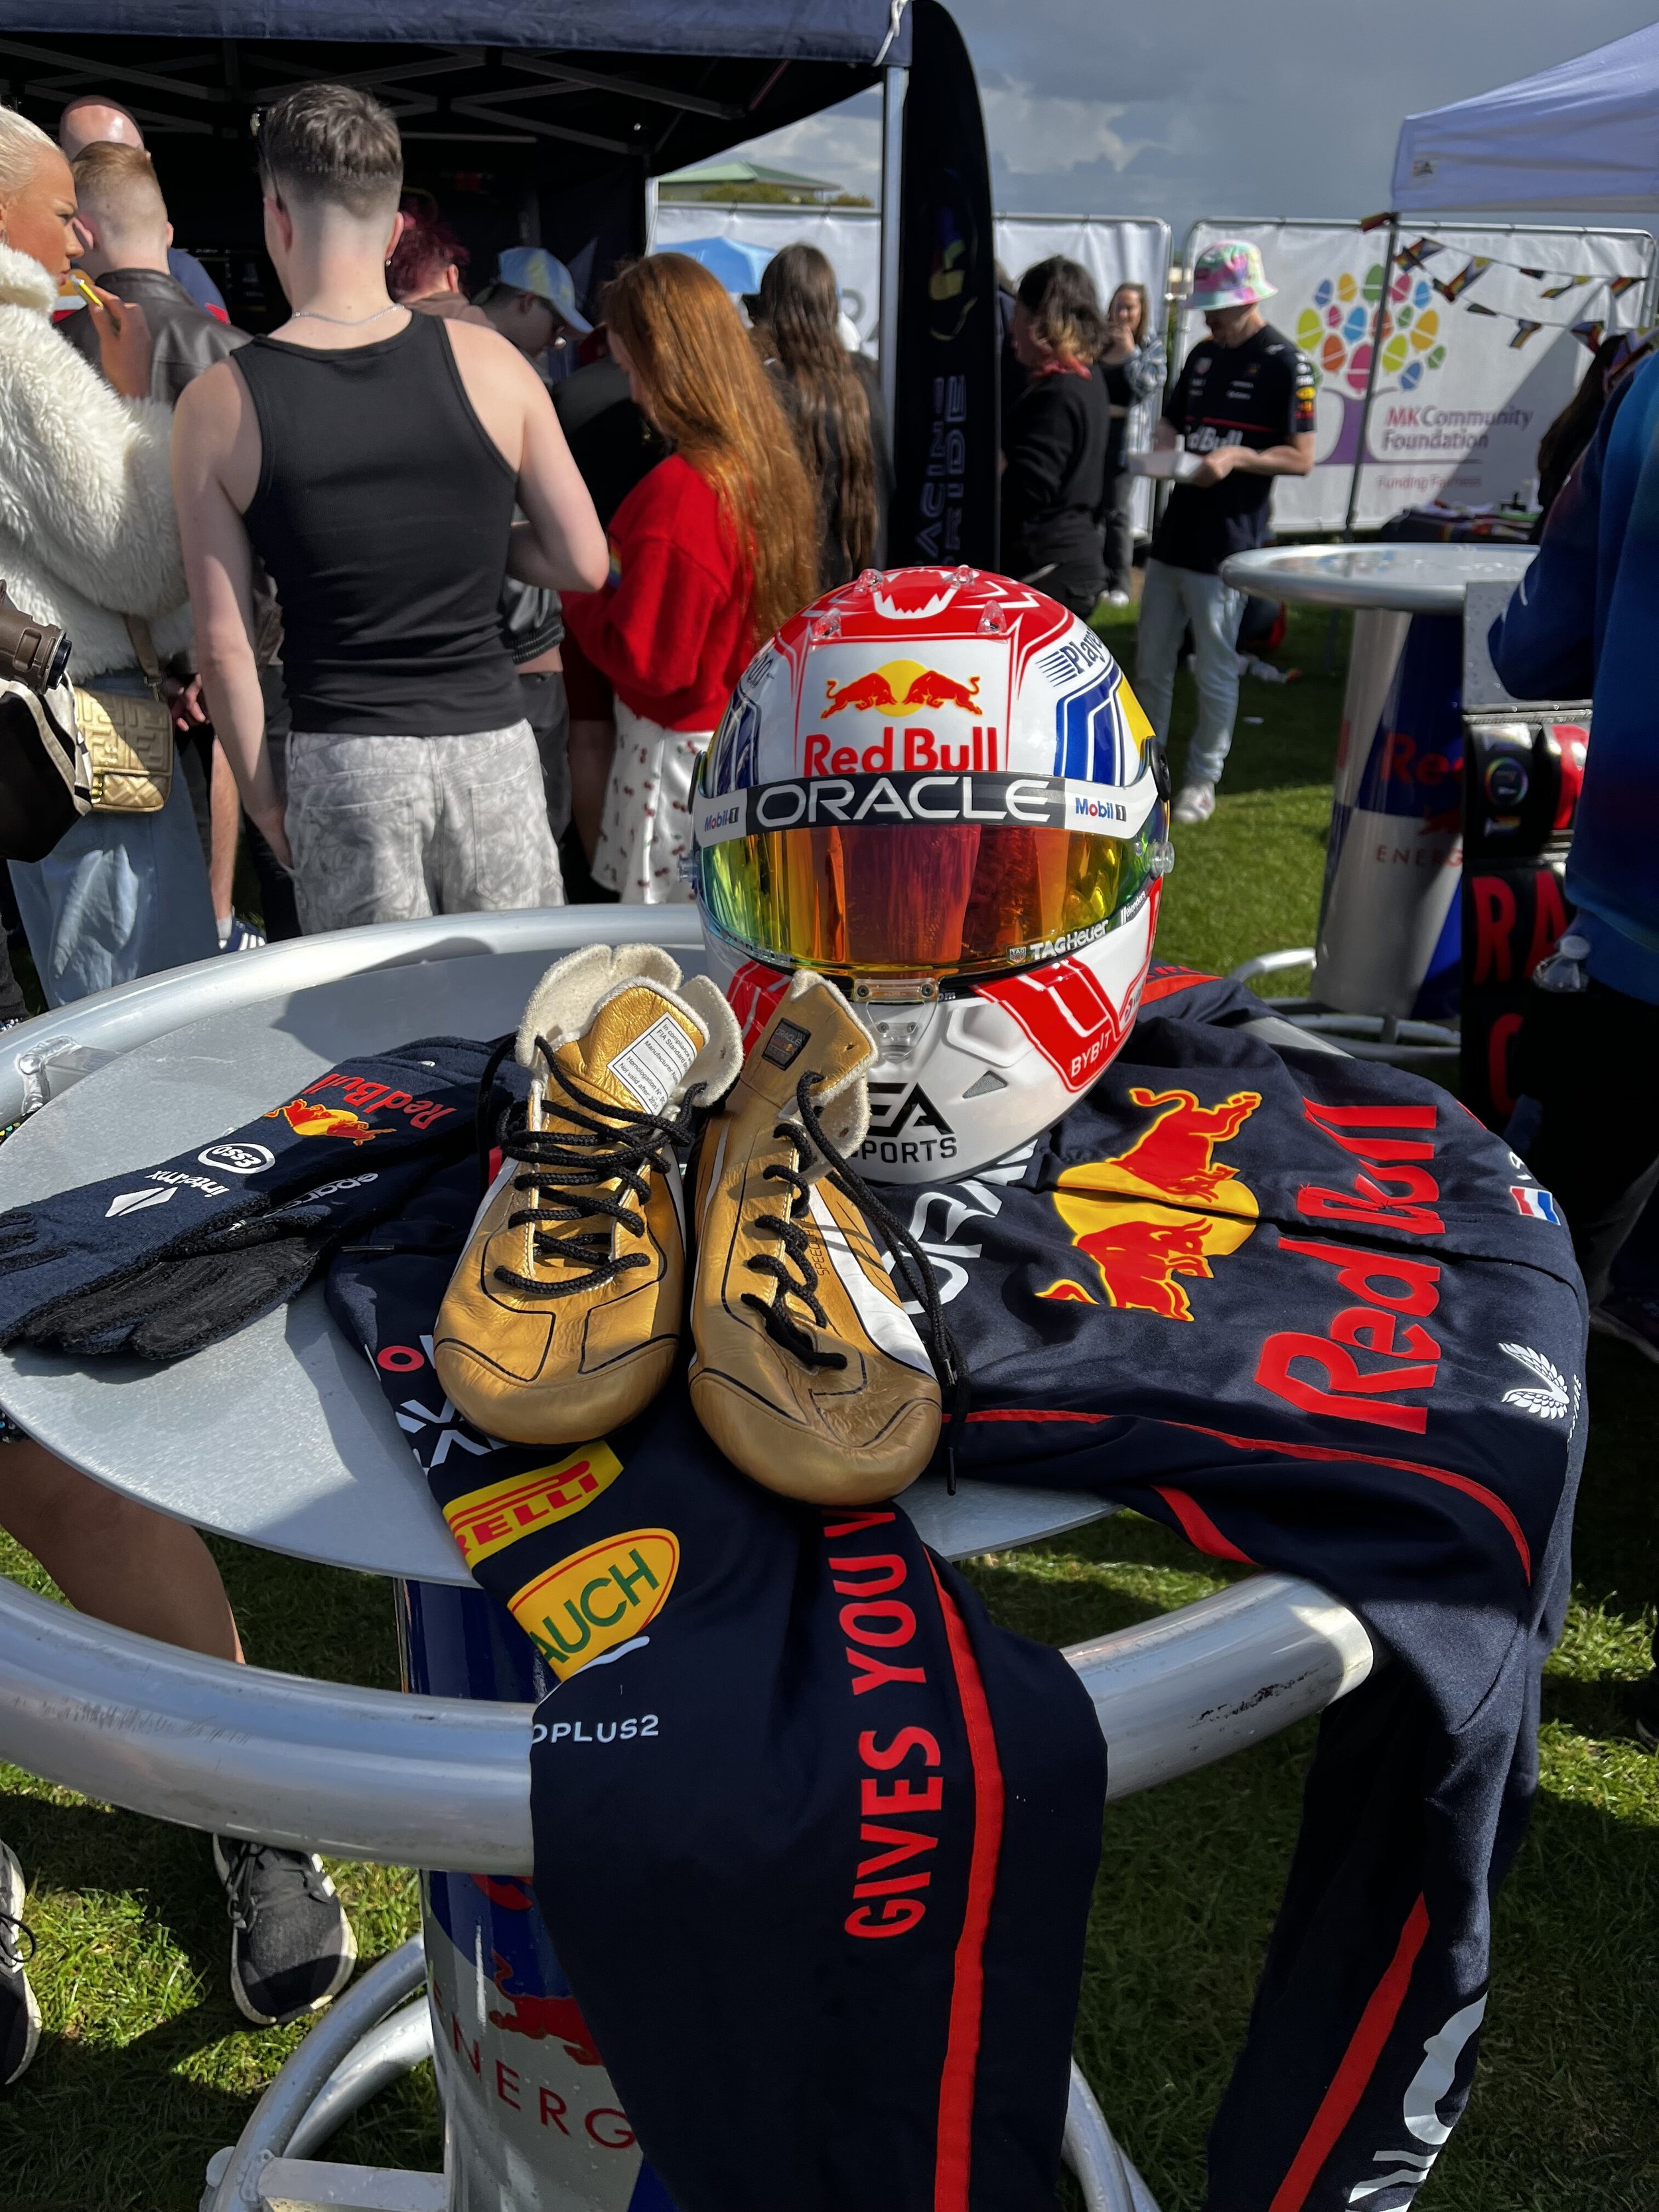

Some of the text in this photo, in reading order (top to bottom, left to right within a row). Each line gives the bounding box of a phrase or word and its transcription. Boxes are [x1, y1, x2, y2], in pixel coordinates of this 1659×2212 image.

[1382, 429, 1488, 449] Foundation
[1378, 475, 1427, 490] Funding
[1059, 627, 1106, 674] Playe
[804, 727, 997, 776] Red Bull
[1380, 732, 1464, 786] Re
[756, 776, 1051, 826] ORACLE
[1076, 798, 1114, 819] Mobil
[704, 810, 729, 832] Mobil
[1376, 844, 1463, 867] ENERG
[644, 1040, 673, 1073] Manufacturer
[656, 1029, 685, 1063] FIA Standard
[668, 1028, 690, 1058] compliance
[1070, 1029, 1113, 1078] BYBIT
[618, 1062, 628, 1074] Not
[628, 1070, 640, 1087] valid
[626, 1056, 660, 1092] Homologation
[302, 1073, 458, 1130] Red Bull
[211, 1146, 262, 1167] Esso
[851, 1136, 958, 1163] PORTS
[1255, 1236, 1441, 1435] Red
[529, 1548, 660, 1663] AUCH
[828, 1554, 926, 1695] YOU
[845, 1726, 943, 1938] GIVES
[433, 1979, 635, 2149] ENERG
